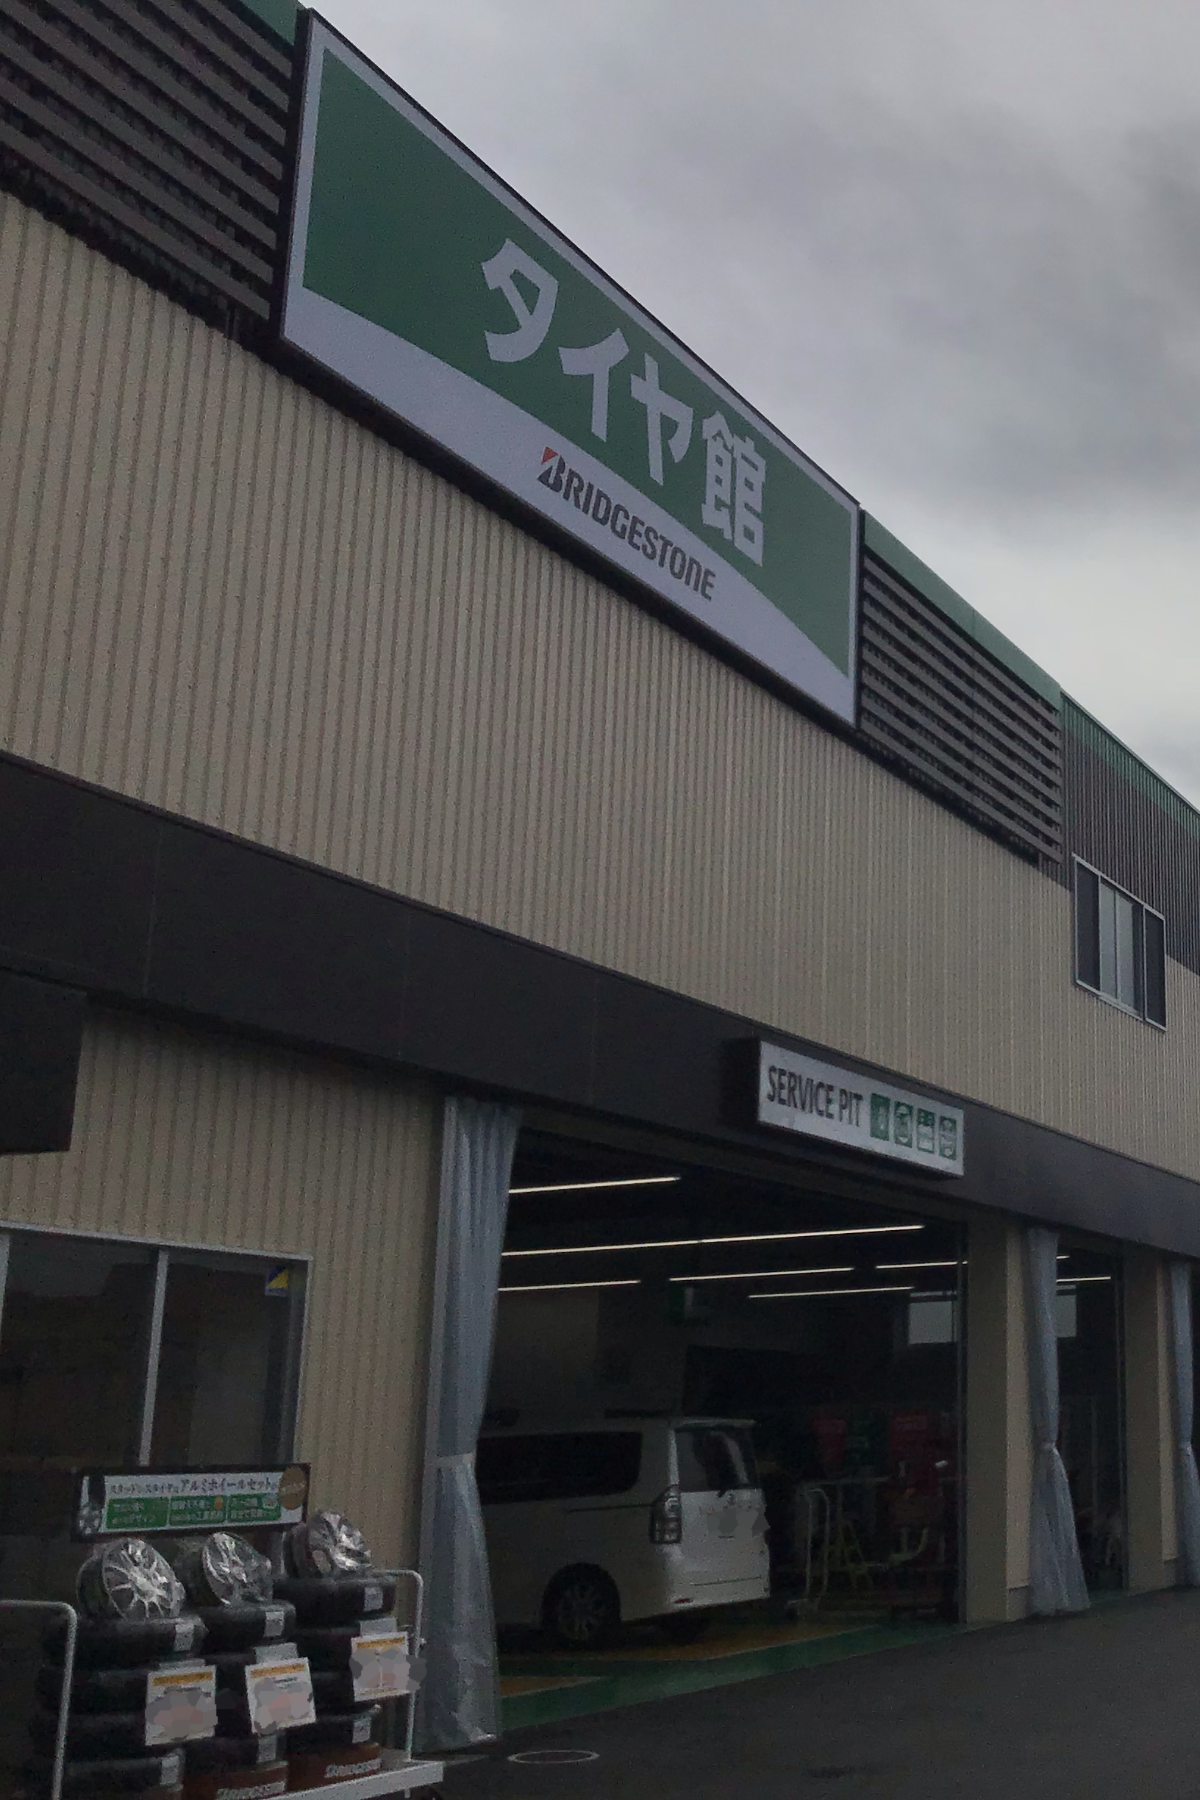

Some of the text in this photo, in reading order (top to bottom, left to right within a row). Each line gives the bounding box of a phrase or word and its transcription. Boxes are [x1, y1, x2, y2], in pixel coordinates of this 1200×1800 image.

[480, 237, 766, 567] タイヤ館
[539, 445, 716, 601] BRIDGESTONE
[767, 1065, 863, 1127] SERVICE PIT
